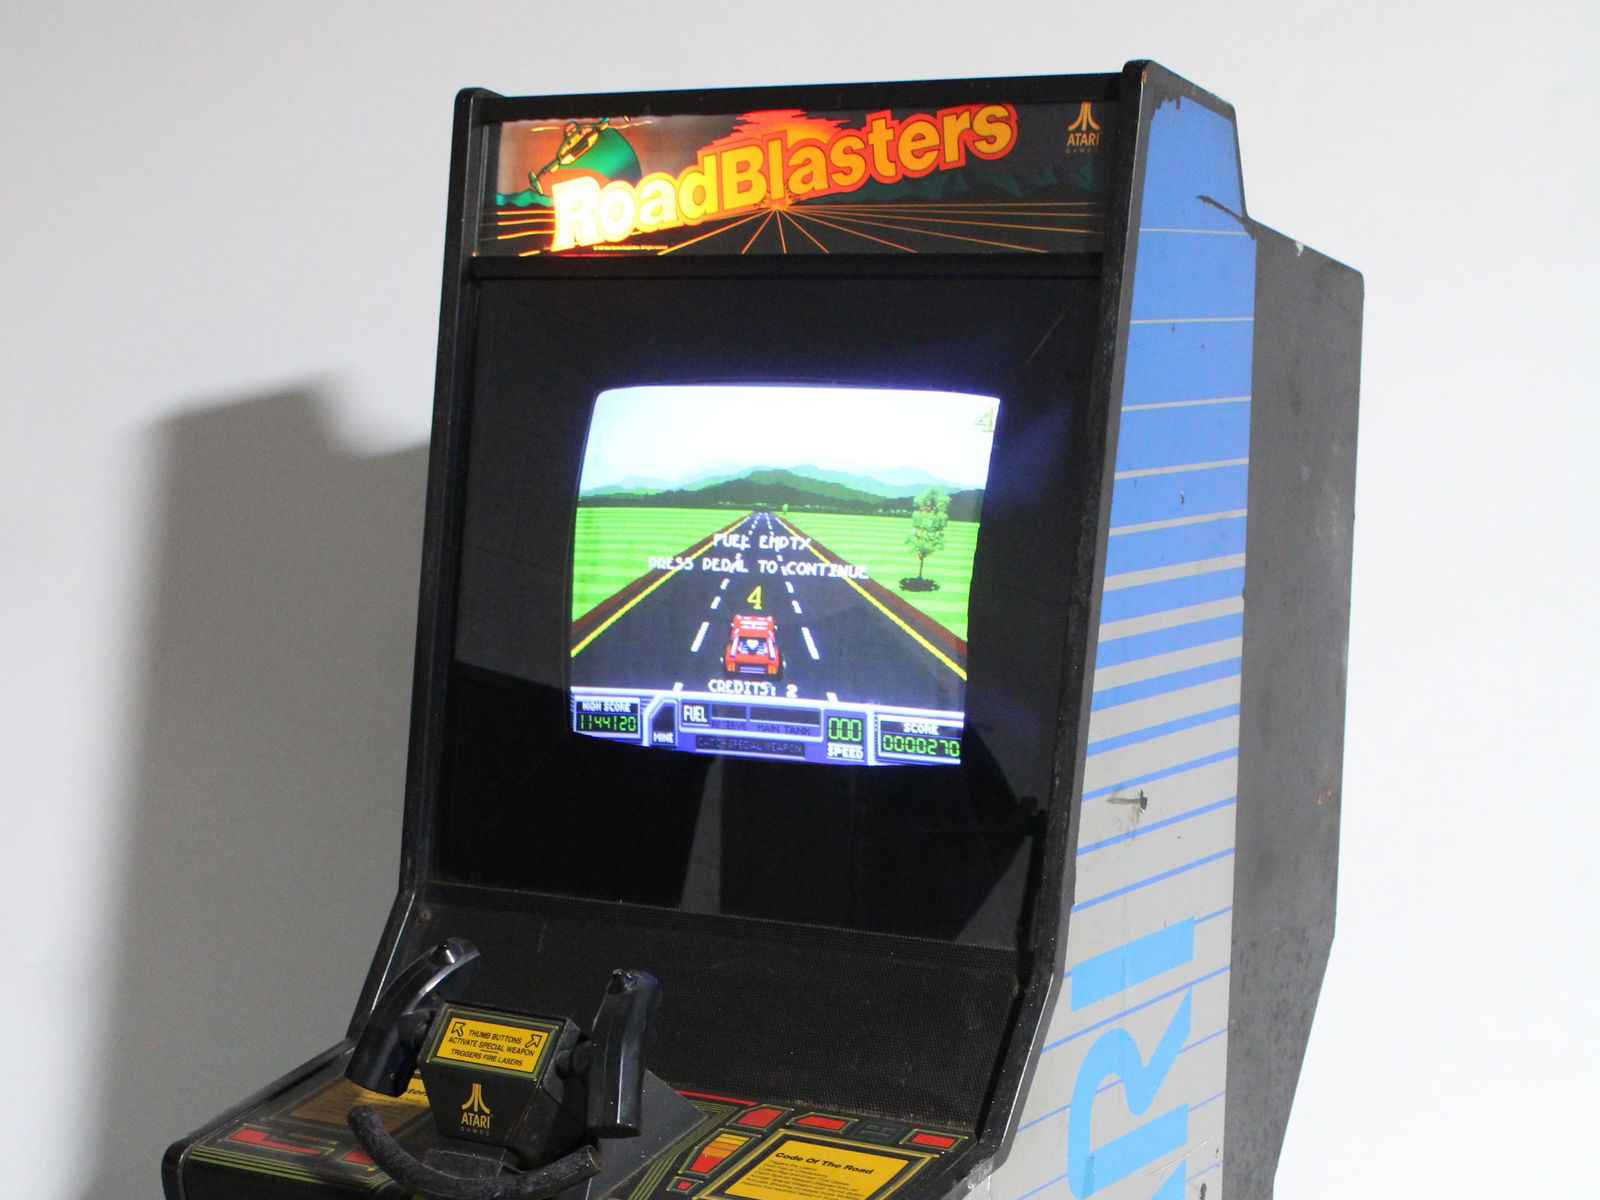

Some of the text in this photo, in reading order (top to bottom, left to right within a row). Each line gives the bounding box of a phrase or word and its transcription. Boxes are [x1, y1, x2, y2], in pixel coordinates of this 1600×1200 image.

[1066, 132, 1100, 147] ATARI
[550, 102, 1018, 252] RoadBlasters
[713, 533, 812, 551] FUEL EMPTY
[648, 556, 870, 580] PRESS PEDAL TO CONTINUE
[747, 585, 763, 610] 4
[786, 684, 799, 698] 2
[603, 702, 631, 713] SCORE
[683, 704, 708, 722] FUEL
[580, 714, 637, 732] 1144120
[784, 726, 812, 736] TANK
[828, 717, 862, 742] 000
[903, 721, 939, 735] SCORE
[653, 732, 674, 744] MINE
[882, 735, 960, 757] 0000270
[827, 742, 864, 760] SPEED
[469, 1029, 522, 1044] THUMB BUTTONS
[448, 1037, 535, 1056] ACTIVATE SPECIAL WEAPON
[451, 1048, 524, 1066] TRIGGERS FIRE LASERS
[461, 1111, 490, 1129] ATARI
[775, 1152, 804, 1162] Code
[822, 1160, 842, 1168] The
[843, 1165, 875, 1175] Road
